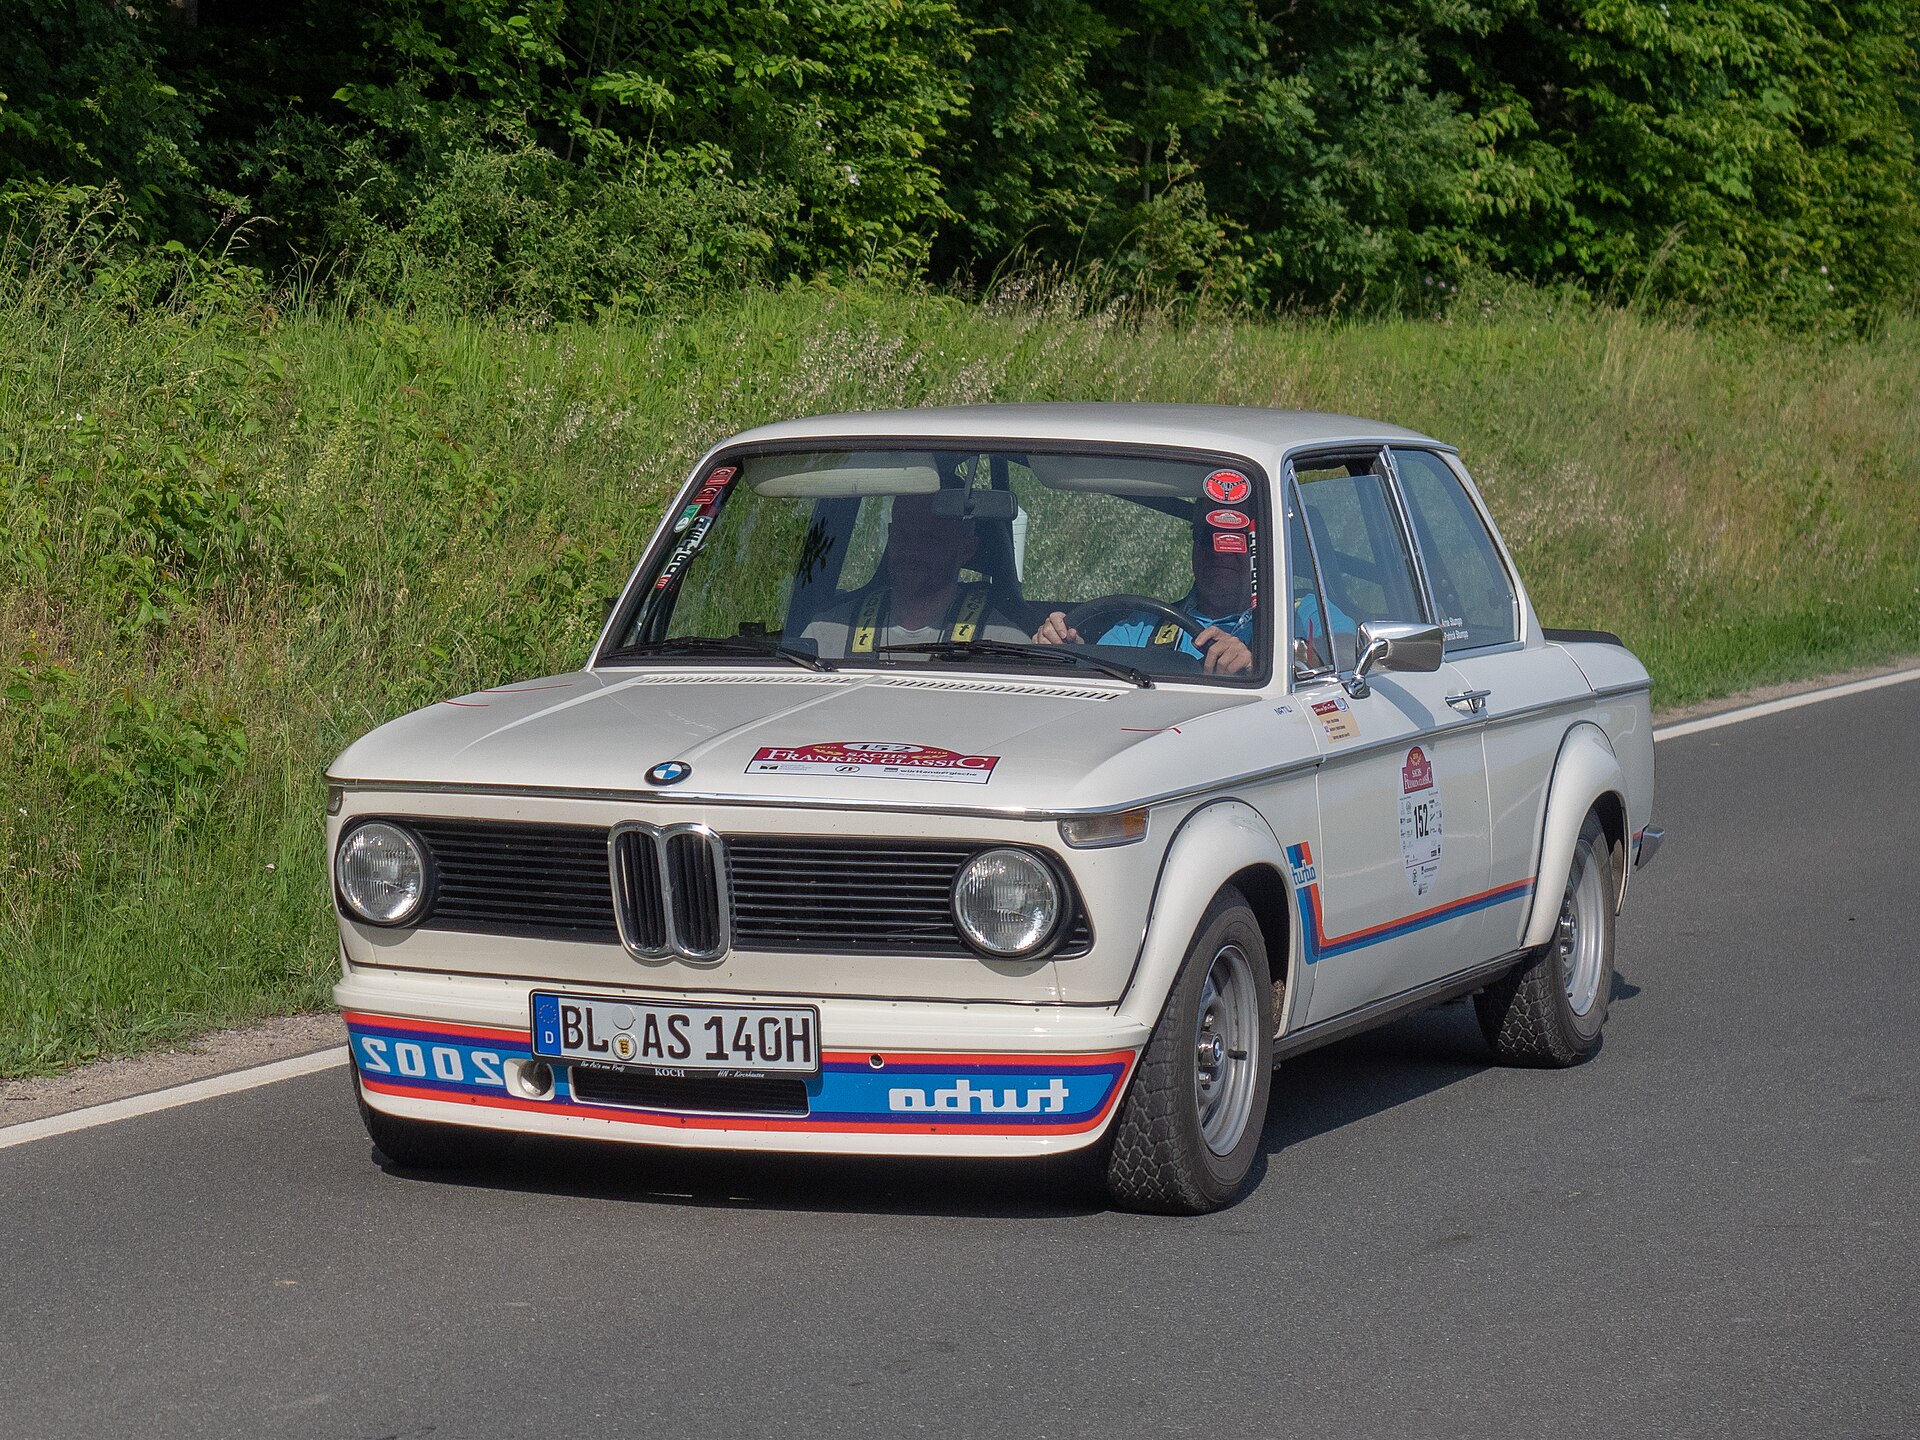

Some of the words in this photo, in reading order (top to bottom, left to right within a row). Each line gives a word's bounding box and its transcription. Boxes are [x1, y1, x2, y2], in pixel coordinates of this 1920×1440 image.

[845, 752, 908, 760] SACHS
[857, 743, 912, 753] 152
[762, 748, 874, 764] FRANKEN
[881, 756, 989, 769] CLASSIC
[1414, 803, 1429, 839] 152
[1291, 863, 1317, 885] turbo
[545, 1031, 554, 1044] D
[560, 1004, 609, 1053] BL
[642, 1012, 691, 1060] AS
[703, 1015, 811, 1063] 140H
[654, 1068, 686, 1078] KOCH
